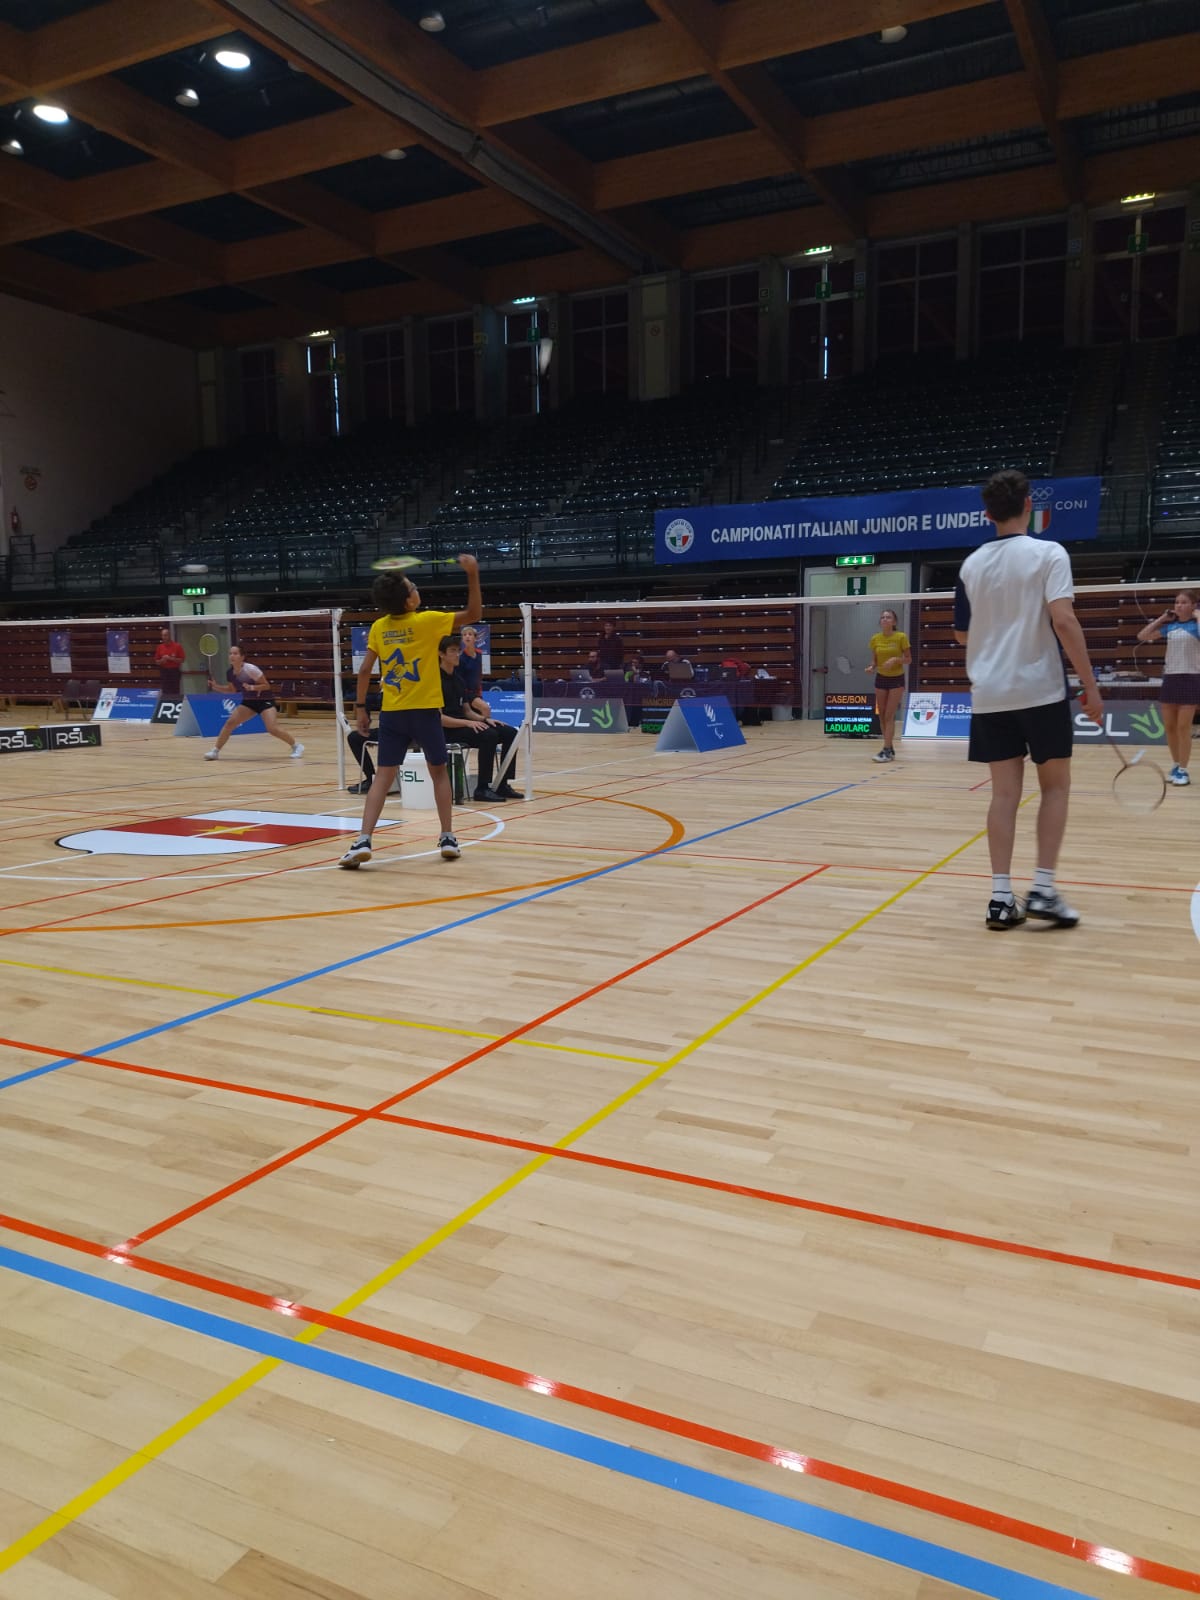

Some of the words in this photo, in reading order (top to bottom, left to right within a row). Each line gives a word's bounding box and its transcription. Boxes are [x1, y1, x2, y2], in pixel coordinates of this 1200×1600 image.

[1055, 499, 1088, 511] CONI
[711, 523, 796, 544] CAMPIONATI
[797, 519, 859, 539] ITALIANI
[861, 514, 918, 535] JUNIOR
[922, 513, 933, 531] E
[936, 509, 991, 531] UNDER
[532, 707, 591, 728] RSL
[1073, 712, 1130, 737] SL
[0, 734, 34, 749] RSL
[56, 731, 89, 746] RSL
